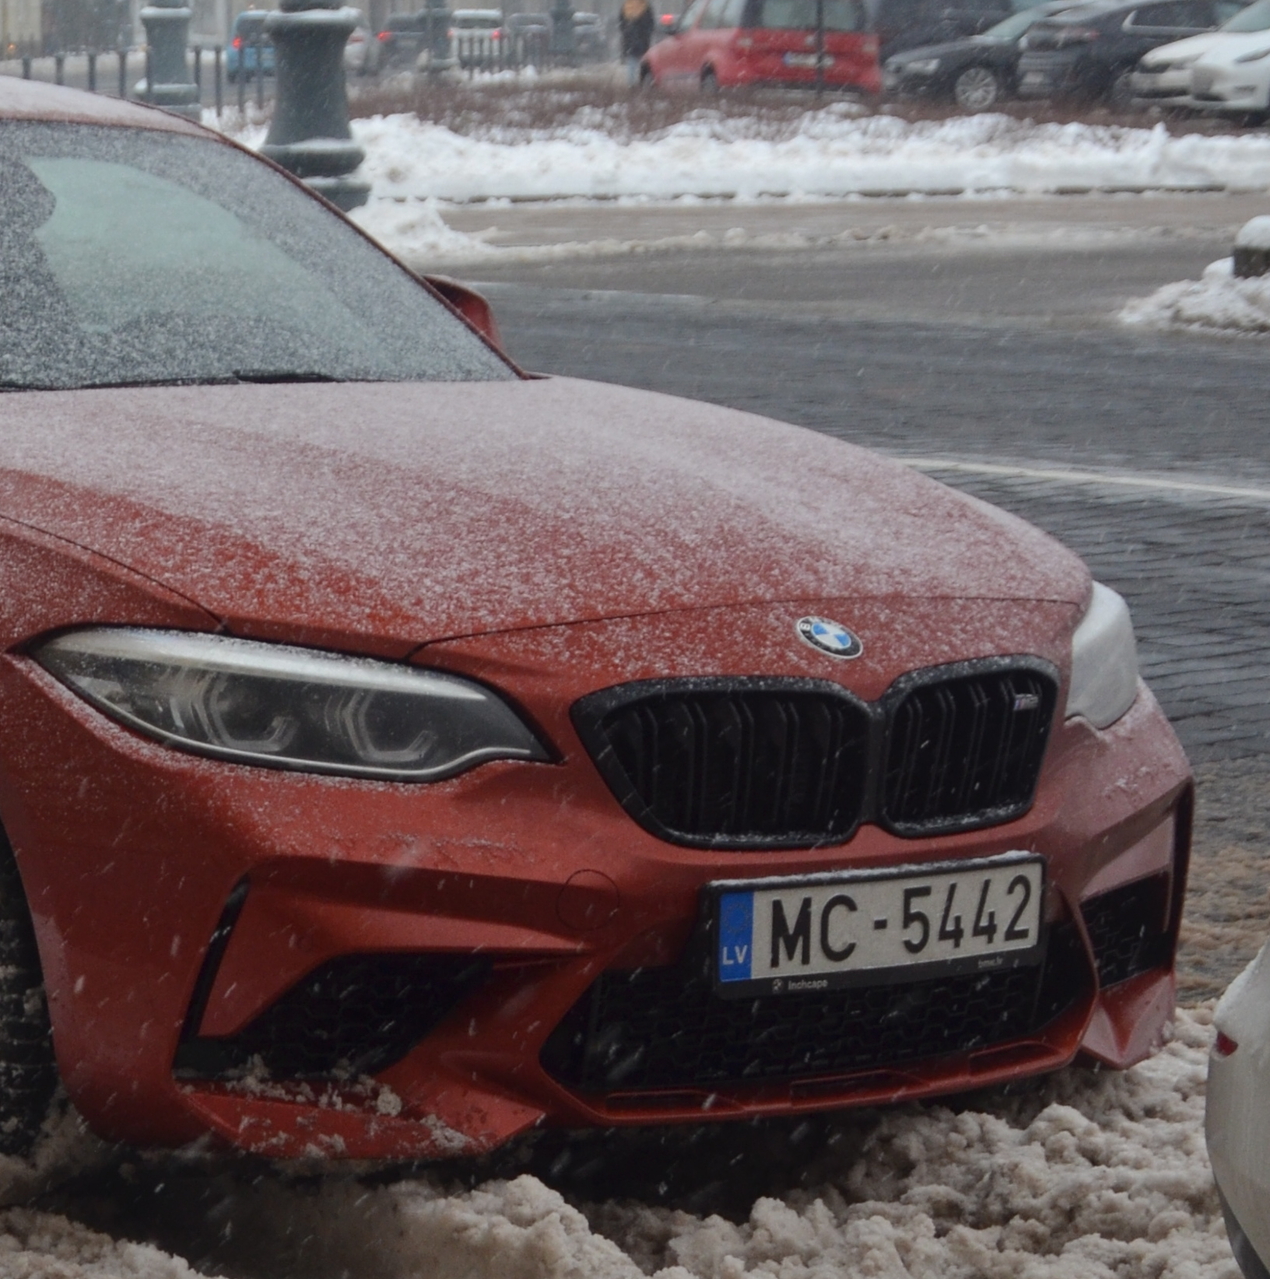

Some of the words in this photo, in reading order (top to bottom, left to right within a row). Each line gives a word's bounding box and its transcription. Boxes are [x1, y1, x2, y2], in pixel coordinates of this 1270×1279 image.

[770, 874, 1031, 968] MC-5442
[722, 944, 749, 966] LV
[788, 979, 828, 991] Inchcape
